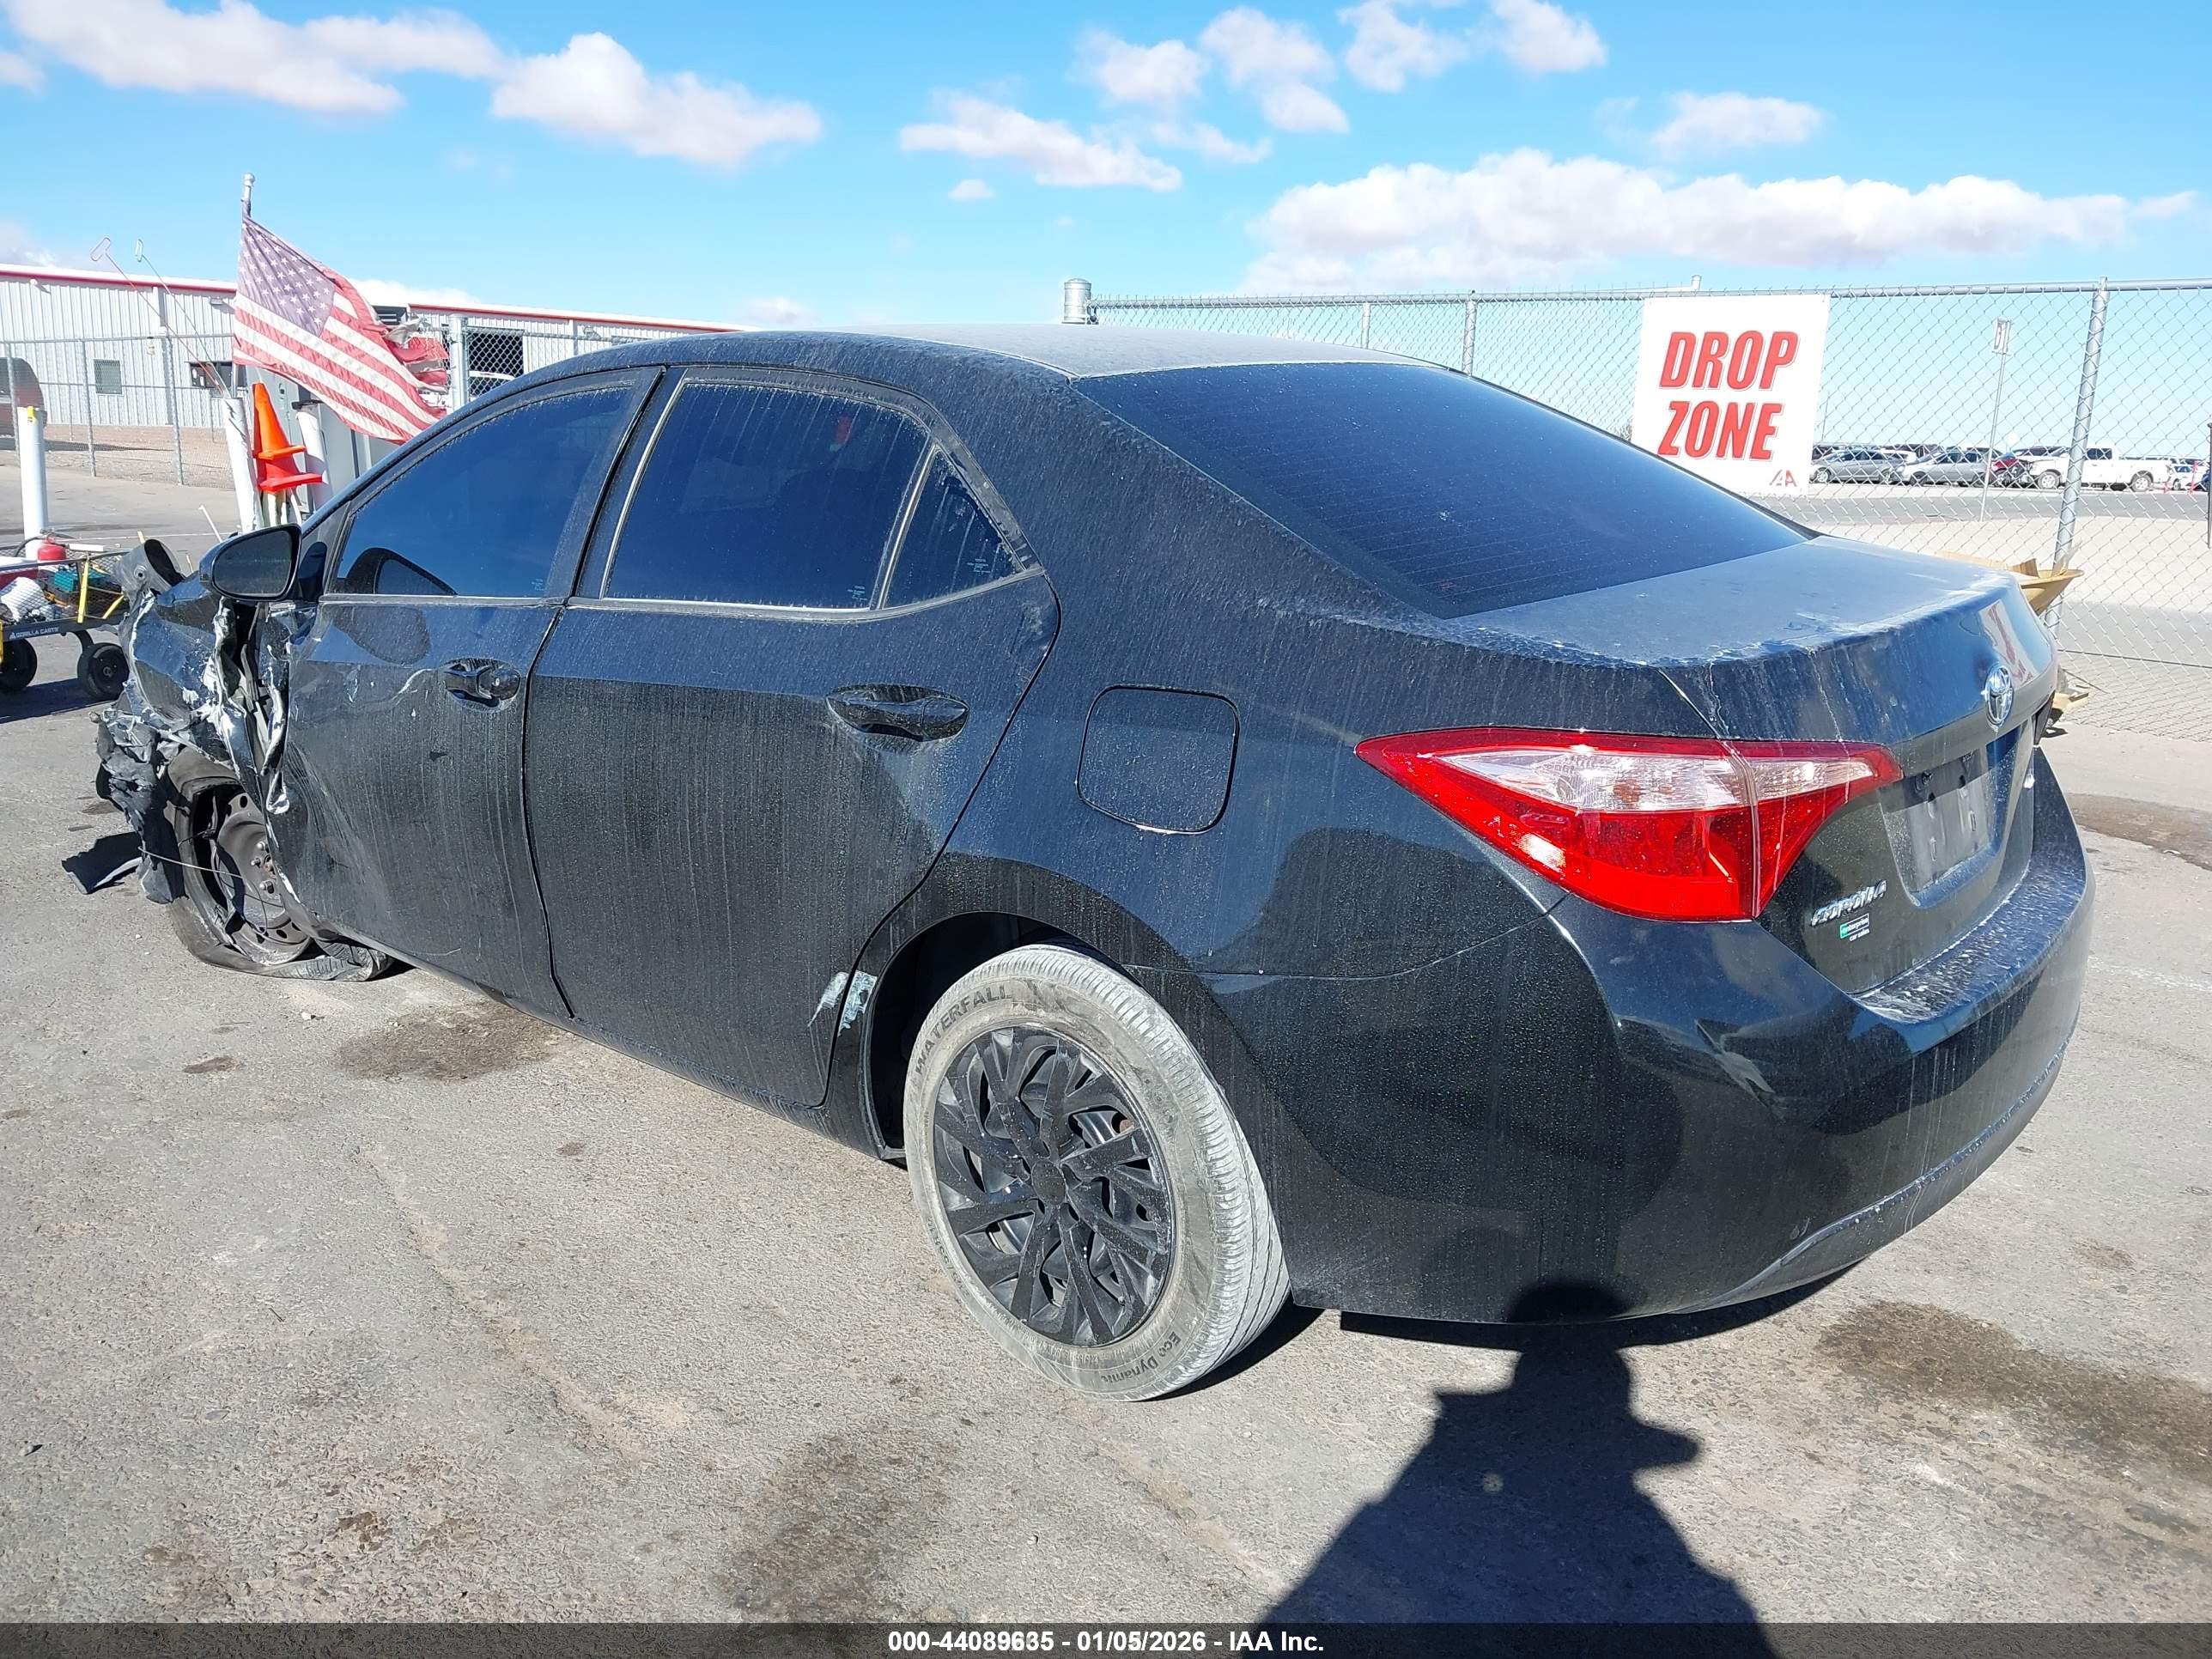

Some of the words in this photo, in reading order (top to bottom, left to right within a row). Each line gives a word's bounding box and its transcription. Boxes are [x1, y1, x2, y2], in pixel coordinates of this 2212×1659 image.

[1659, 330, 1800, 391] DROP
[1657, 400, 1784, 461] ZONE
[915, 985, 1012, 1074] WATERFALL
[1100, 1355, 1159, 1383] Dynamic
[1158, 1331, 1182, 1358] Eco
